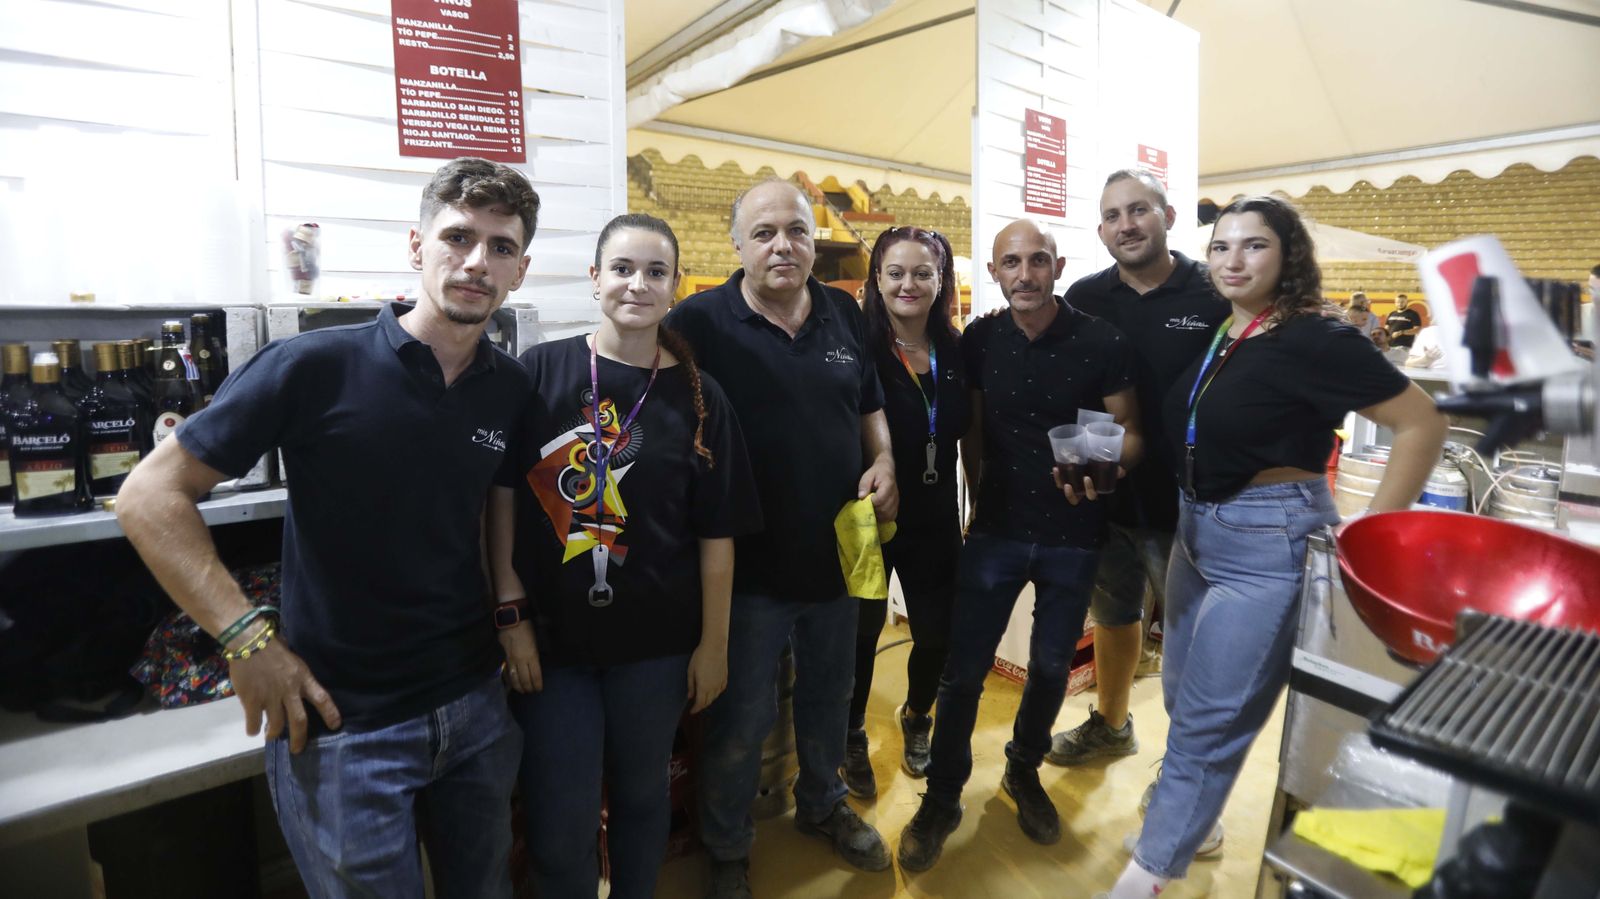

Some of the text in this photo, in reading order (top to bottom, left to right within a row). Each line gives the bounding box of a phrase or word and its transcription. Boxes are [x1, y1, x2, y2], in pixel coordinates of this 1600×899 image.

[440, 9, 469, 19] VASOS
[396, 27, 413, 37] TÍO
[415, 29, 438, 40] PEPE
[399, 38, 515, 61] RESTO 2,50
[430, 65, 487, 81] BOTELLA
[400, 87, 416, 97] TÍO
[418, 90, 441, 99] PEPE
[508, 90, 519, 98] 10
[401, 98, 457, 110] BARBADILLO
[458, 104, 475, 112] SAN
[509, 109, 520, 117] 12
[401, 108, 520, 126] BARBADILLO SEMIDULCE 12
[402, 118, 444, 129] VERDEJO
[445, 122, 468, 130] VEGA
[470, 124, 481, 132] LA
[483, 126, 508, 134] REINA
[403, 128, 430, 138] RIOJA
[431, 131, 476, 141] SANTIAGO
[91, 417, 136, 430] ARCELÓ
[13, 433, 70, 446] BARCELÓ
